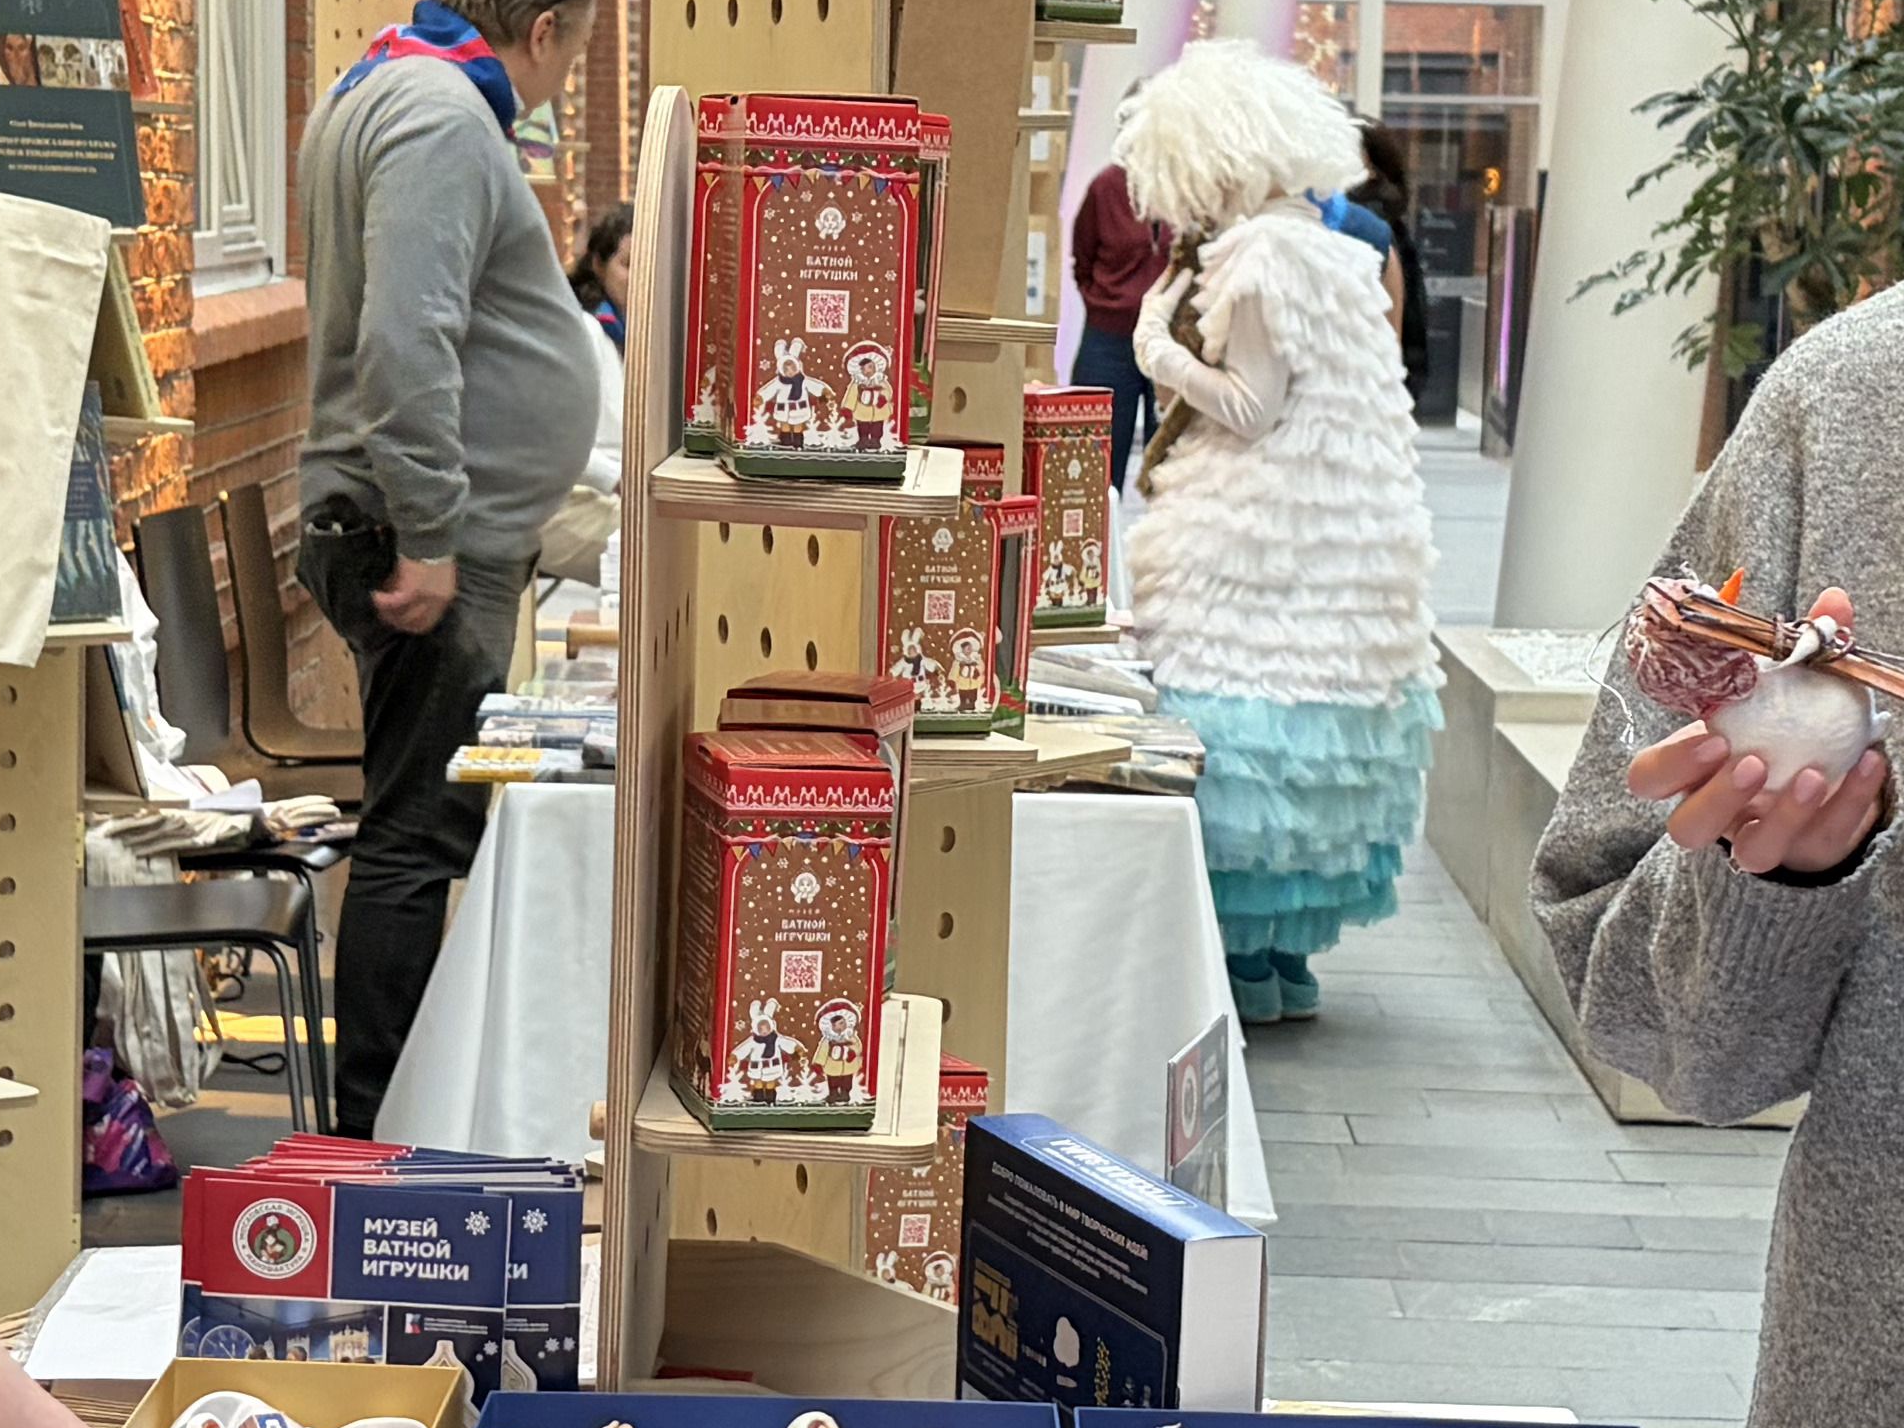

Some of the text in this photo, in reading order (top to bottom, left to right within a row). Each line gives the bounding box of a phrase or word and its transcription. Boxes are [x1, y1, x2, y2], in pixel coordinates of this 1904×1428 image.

[805, 254, 853, 269] ВАТНОЙ
[799, 267, 859, 282] ИГРУШКИ
[781, 916, 826, 930] ВАТНОЙ
[774, 931, 831, 943] ИГРУШКИ
[363, 1217, 438, 1238] МУЗЕЙ
[363, 1238, 451, 1260] ВАТНОЙ
[362, 1261, 470, 1281] ИГРУШКИ
